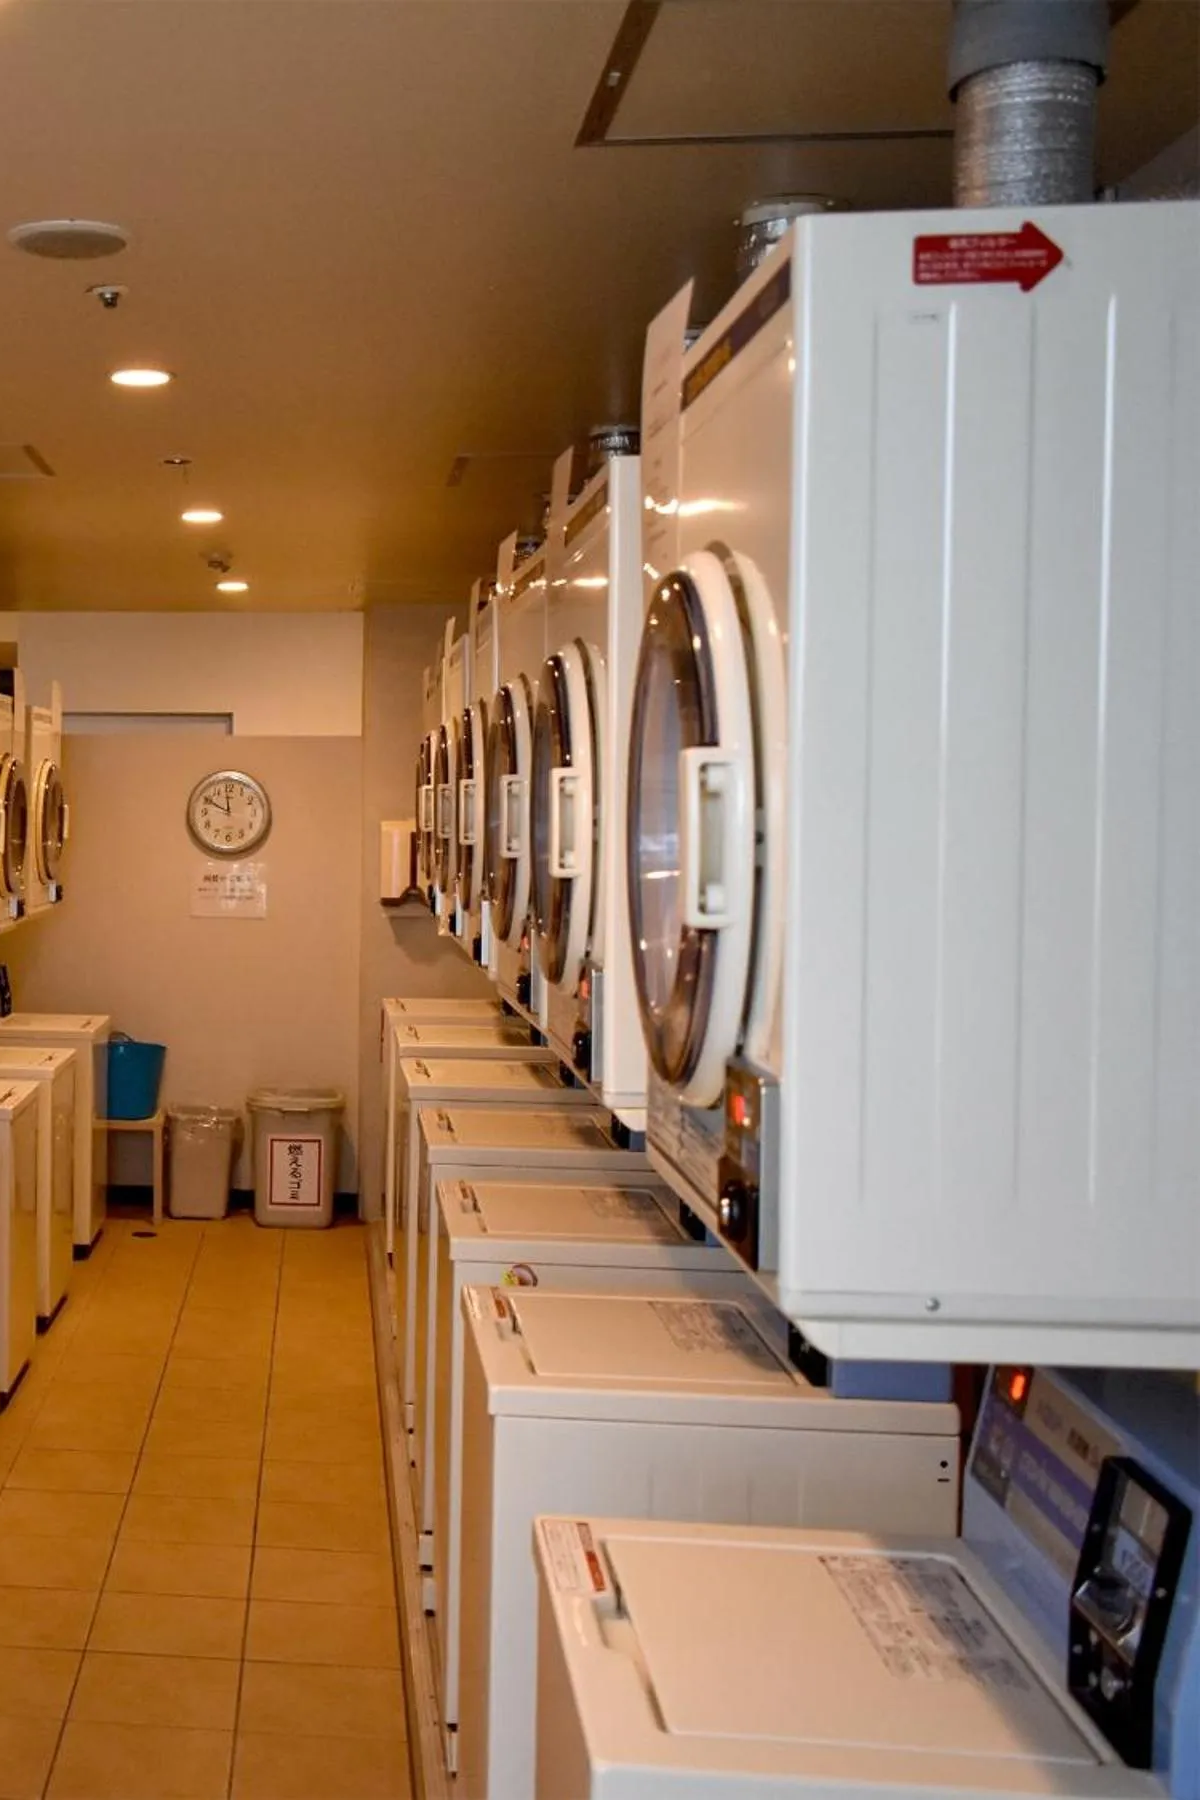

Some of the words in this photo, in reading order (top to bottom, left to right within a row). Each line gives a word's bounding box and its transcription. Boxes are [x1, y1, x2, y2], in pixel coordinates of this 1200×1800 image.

[225, 783, 234, 793] 12
[201, 808, 208, 818] 9
[225, 832, 232, 843] 6
[287, 1143, 304, 1201] 燃えるゴミ
